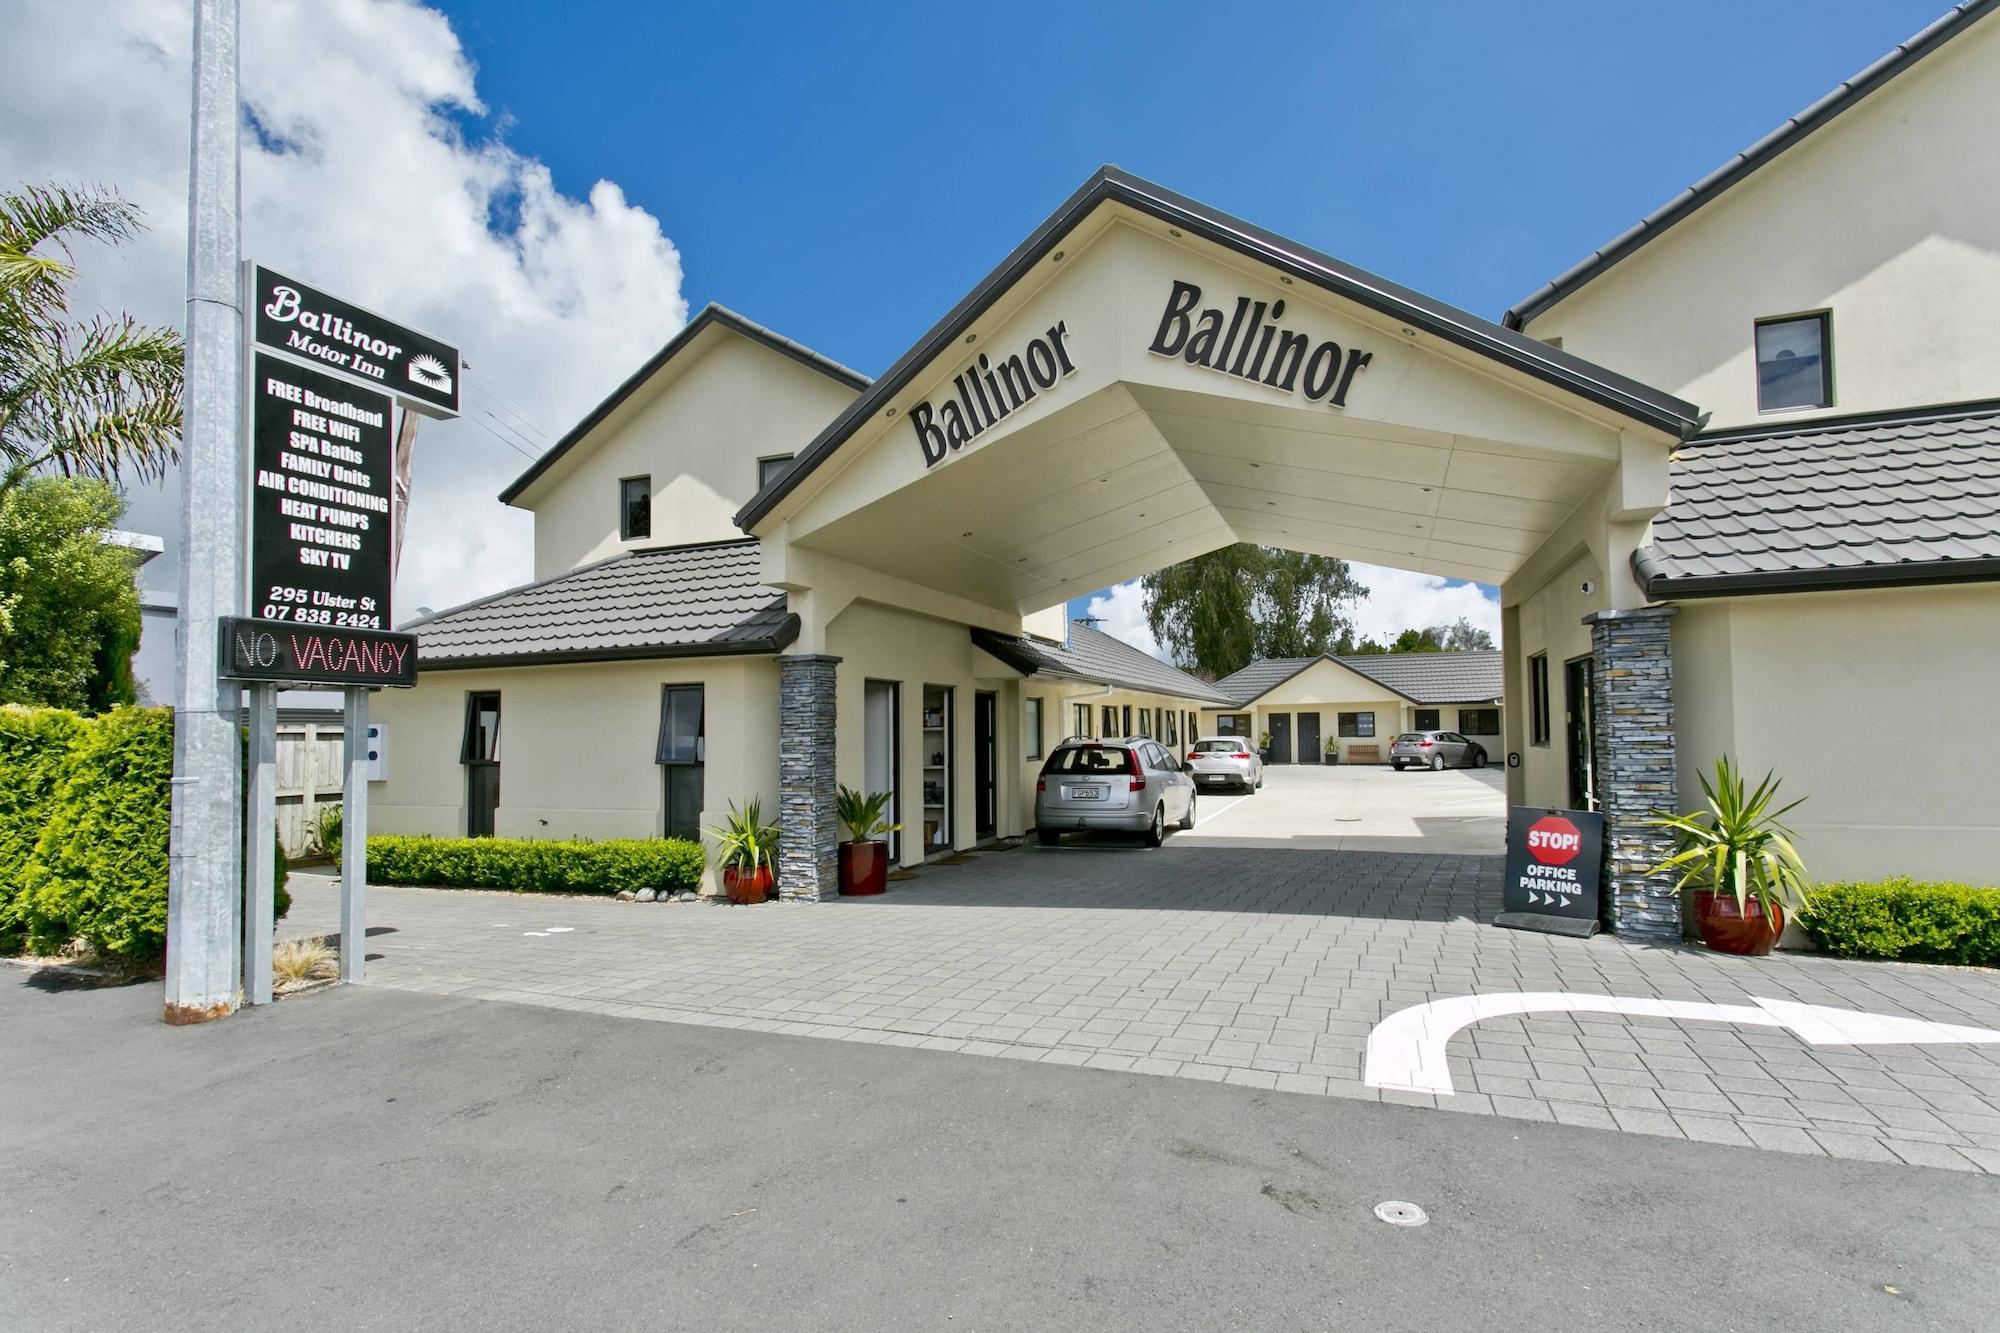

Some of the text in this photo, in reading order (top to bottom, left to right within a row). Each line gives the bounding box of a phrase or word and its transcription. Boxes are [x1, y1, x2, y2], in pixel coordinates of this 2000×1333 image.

[265, 286, 402, 360] Ballinor
[286, 330, 385, 379] Motor Inn
[1148, 279, 1374, 410] Ballinor
[267, 378, 383, 428] FREE Broadband
[908, 319, 1079, 470] Ballinor
[293, 409, 360, 443] FREE WiFi
[289, 431, 363, 464] SPA Baths
[280, 452, 371, 488] FAMILY Units
[258, 470, 388, 513] AIR CONDITIONING
[281, 498, 369, 530] HEAT PUMPS
[290, 523, 361, 550] KITCHENS
[300, 547, 351, 570] SKY TV
[269, 586, 377, 611] 295 Ulster St
[263, 604, 380, 629] 07 838 2424
[236, 632, 408, 674] NO VACANCY
[1528, 830, 1579, 851] STOP!
[1520, 877, 1582, 895] PARKING
[1526, 864, 1577, 880] OFFICE
